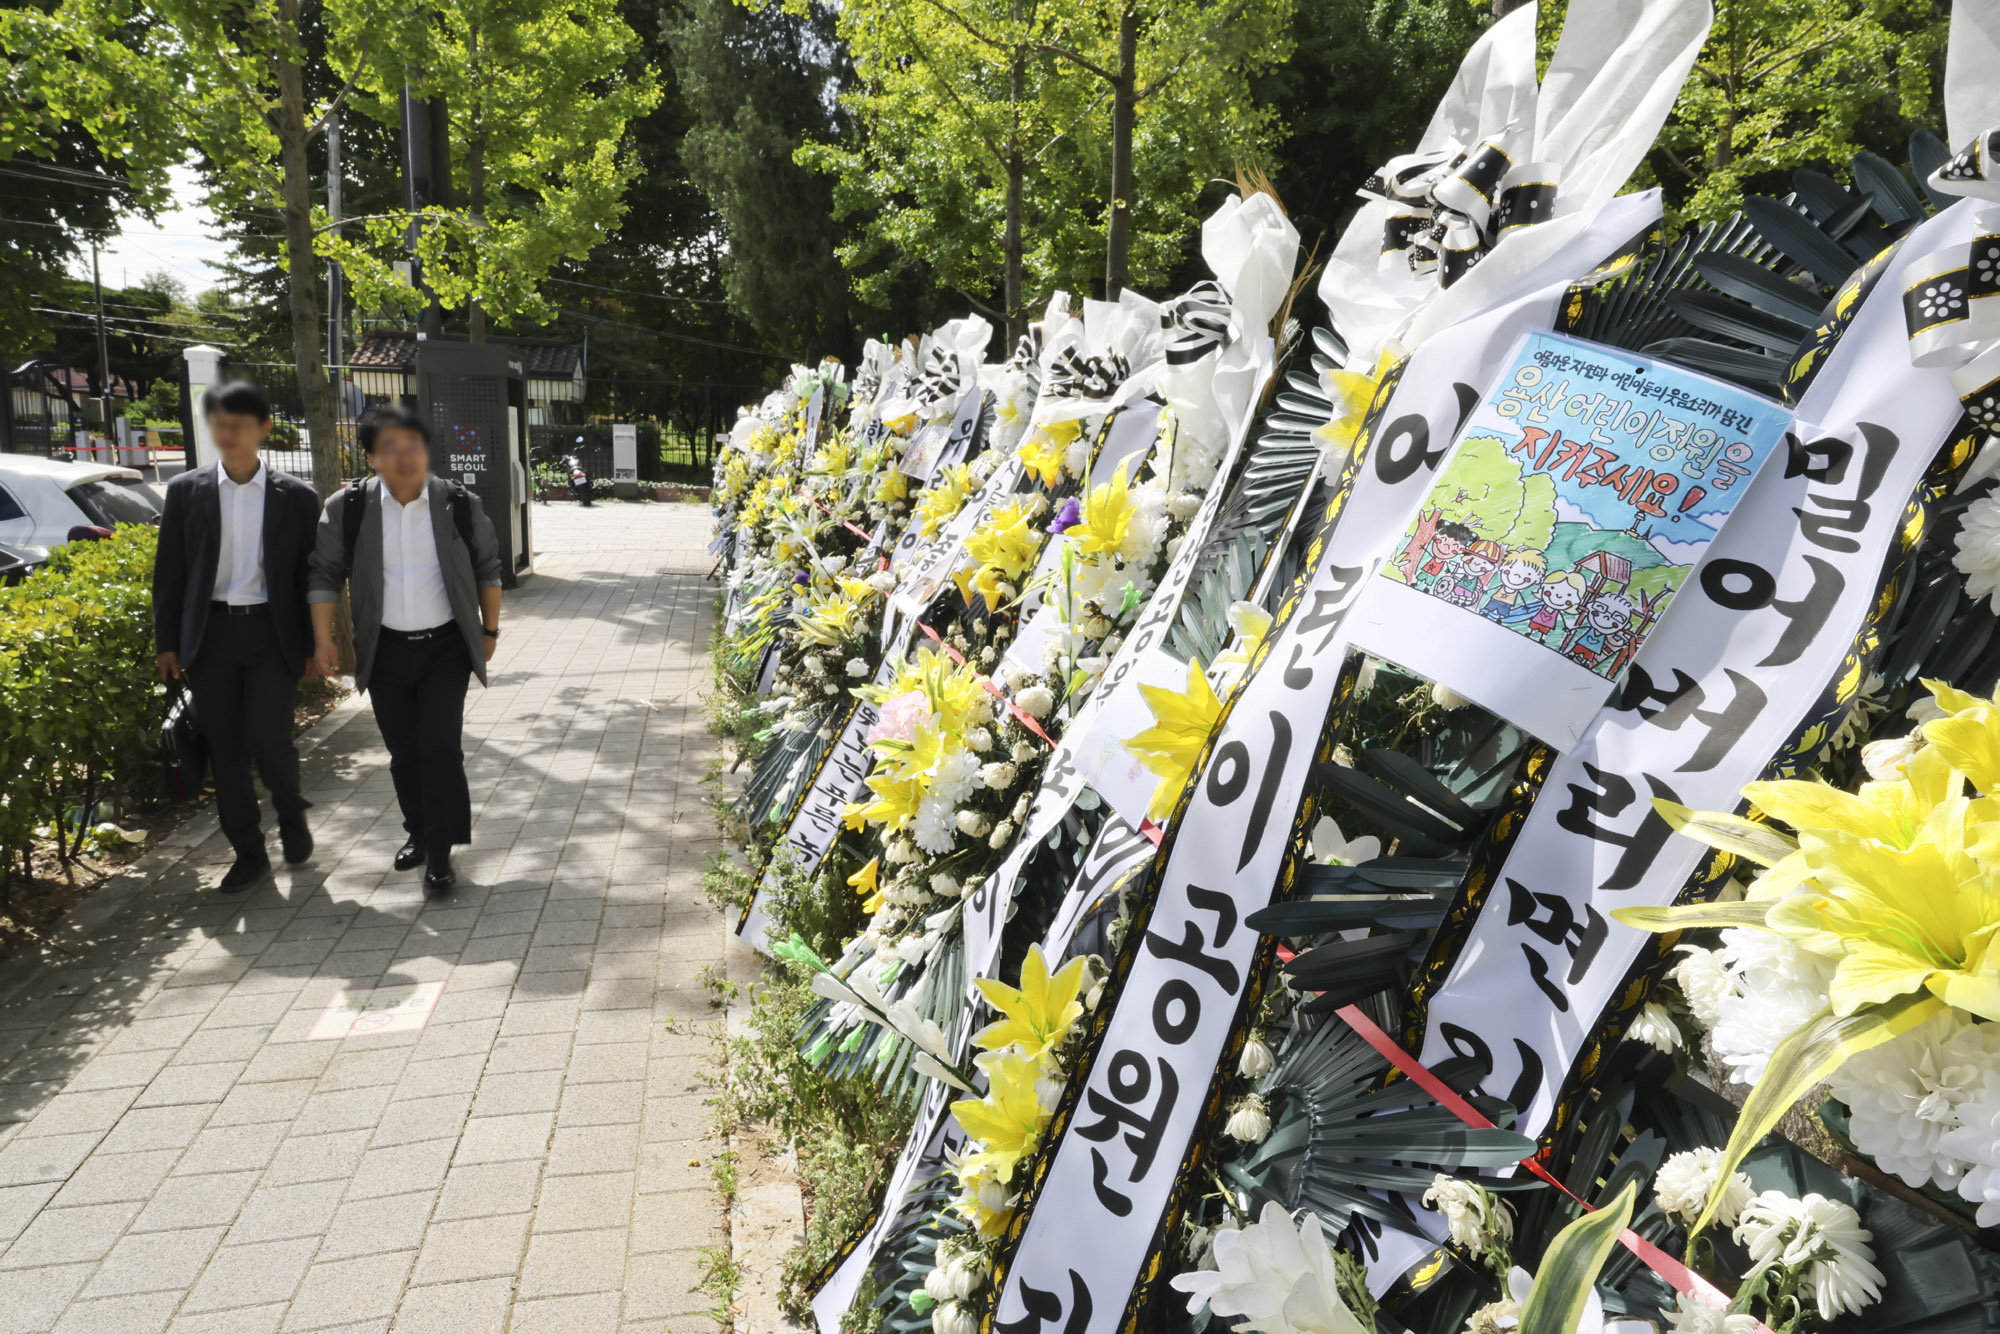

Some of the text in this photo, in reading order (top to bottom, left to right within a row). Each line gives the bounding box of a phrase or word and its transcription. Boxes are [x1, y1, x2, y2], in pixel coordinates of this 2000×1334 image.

[1571, 358, 1609, 382] 자연과
[1610, 372, 1667, 399] 어린이들의
[1664, 387, 1723, 418] 웃음소리가
[1721, 408, 1754, 434] 담긴
[450, 454, 486, 462] SMART
[450, 462, 487, 471] SEOUL
